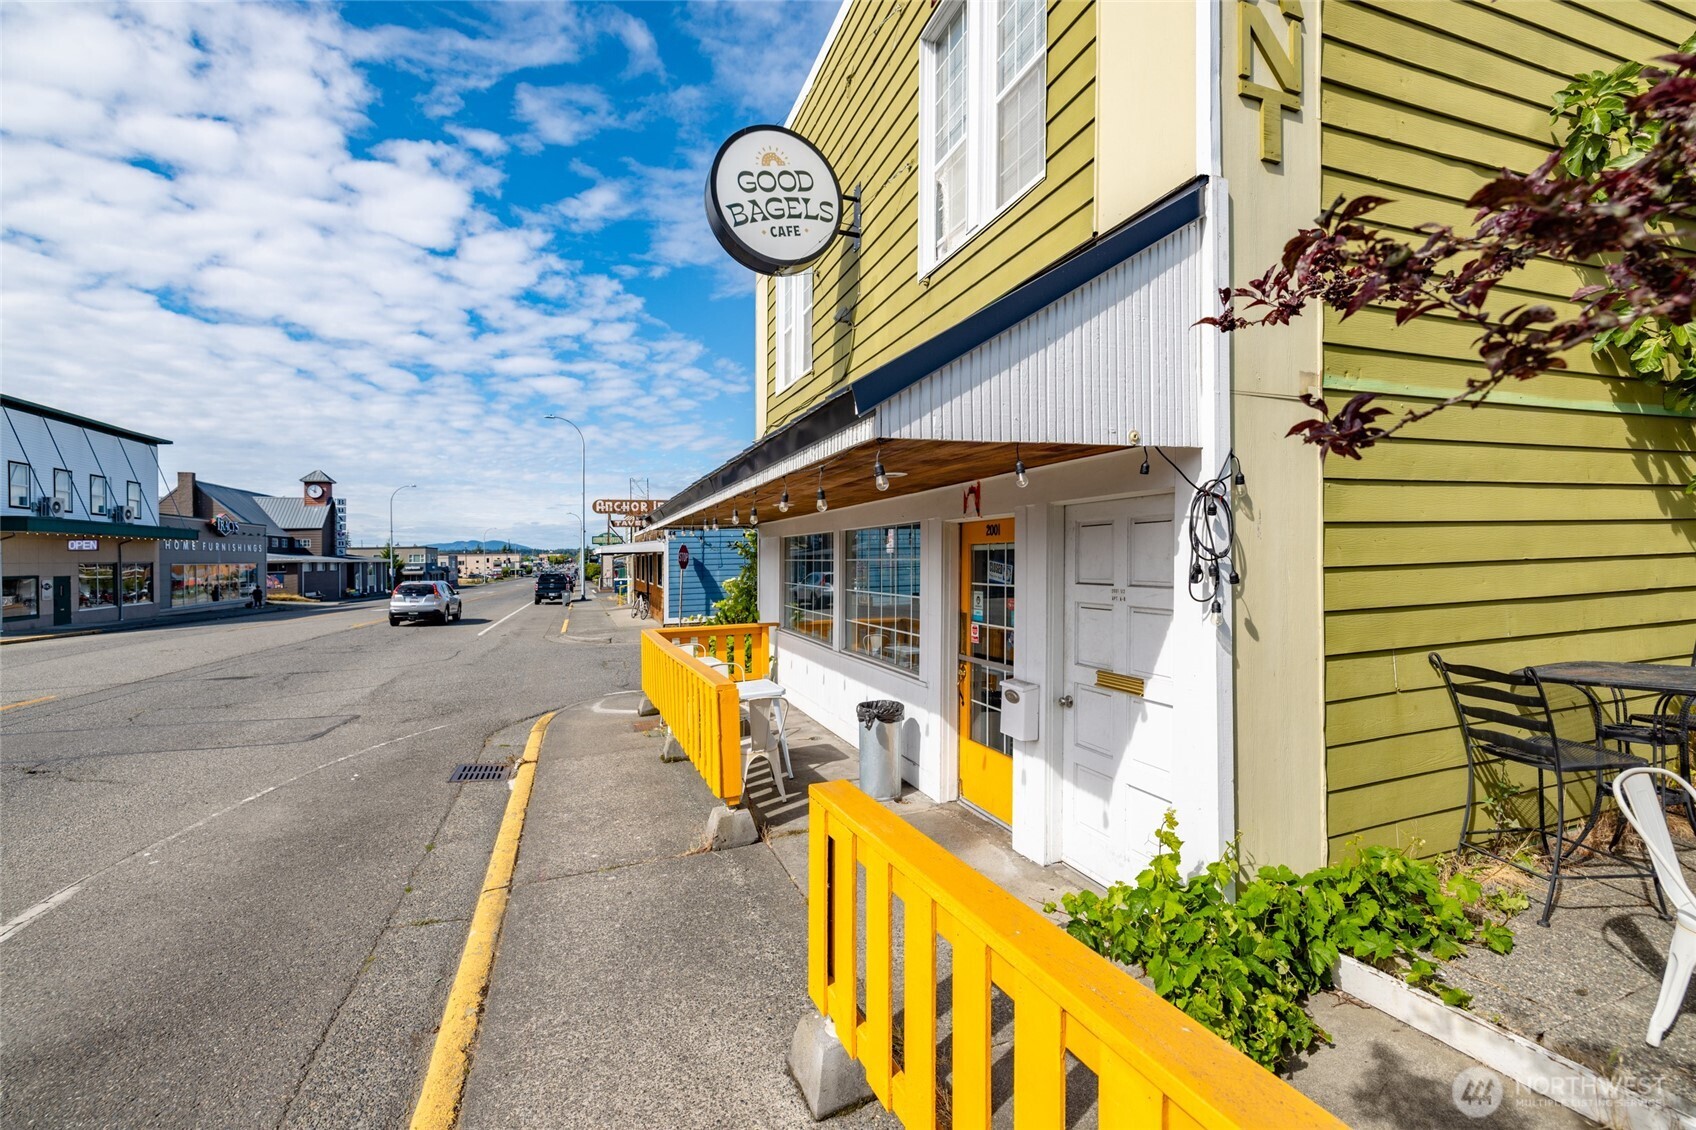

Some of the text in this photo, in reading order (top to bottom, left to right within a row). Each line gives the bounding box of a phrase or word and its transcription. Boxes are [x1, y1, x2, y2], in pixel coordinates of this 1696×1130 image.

[1238, 0, 1304, 165] NT
[737, 170, 814, 193] GOOD
[725, 197, 834, 228] BAGELS
[770, 225, 801, 238] CAFE
[595, 500, 648, 512] ANCHOR
[986, 524, 1000, 536] 2001
[68, 540, 97, 550] OPEN
[164, 541, 262, 552] HOME FURNISHINGS
[679, 552, 688, 561] STOP
